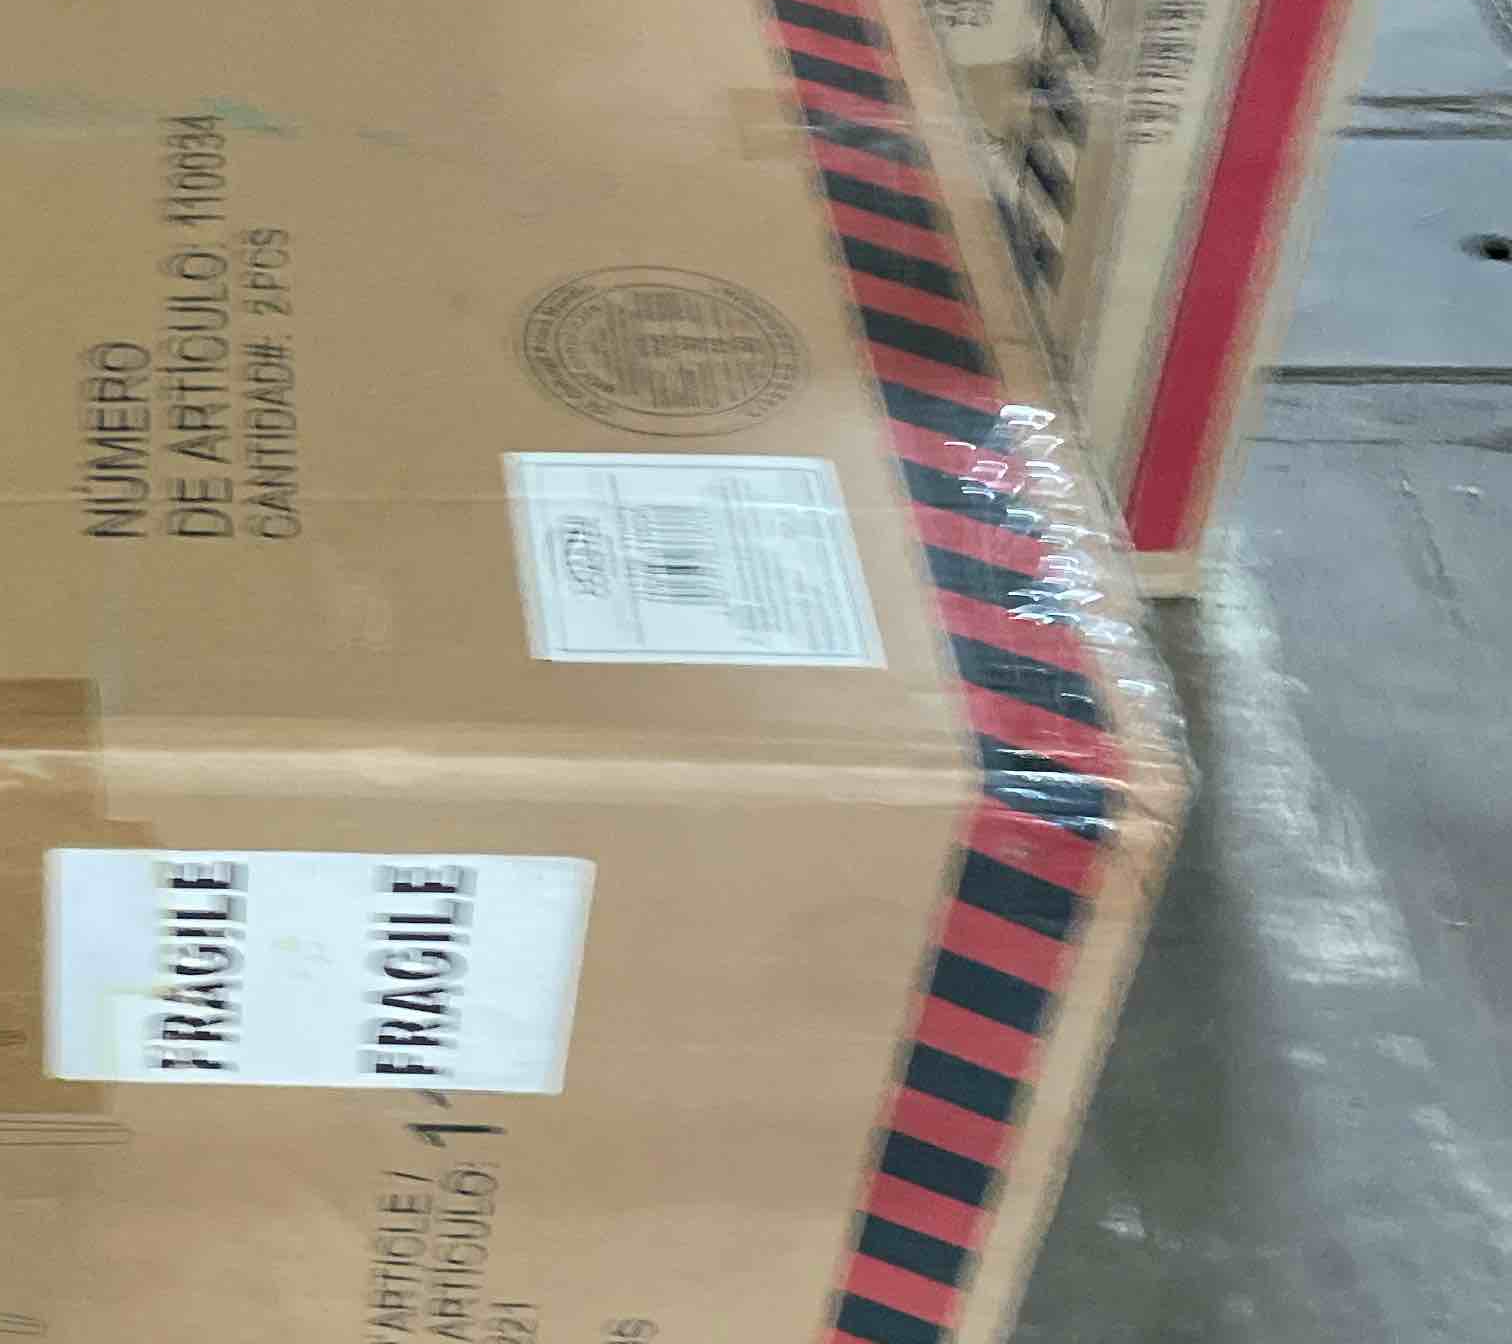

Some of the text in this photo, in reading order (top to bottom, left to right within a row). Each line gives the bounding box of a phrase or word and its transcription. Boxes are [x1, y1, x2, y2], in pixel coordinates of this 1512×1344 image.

[156, 113, 234, 539] DE ARTÍCULO: 110034
[238, 228, 303, 541] CANTIDAD#: 2 PCS
[72, 341, 152, 539] NÚMERO
[143, 859, 249, 1072] FRAGILE
[358, 863, 478, 1078] FRAGILE
[423, 1160, 501, 1341] ARTÍCULO:
